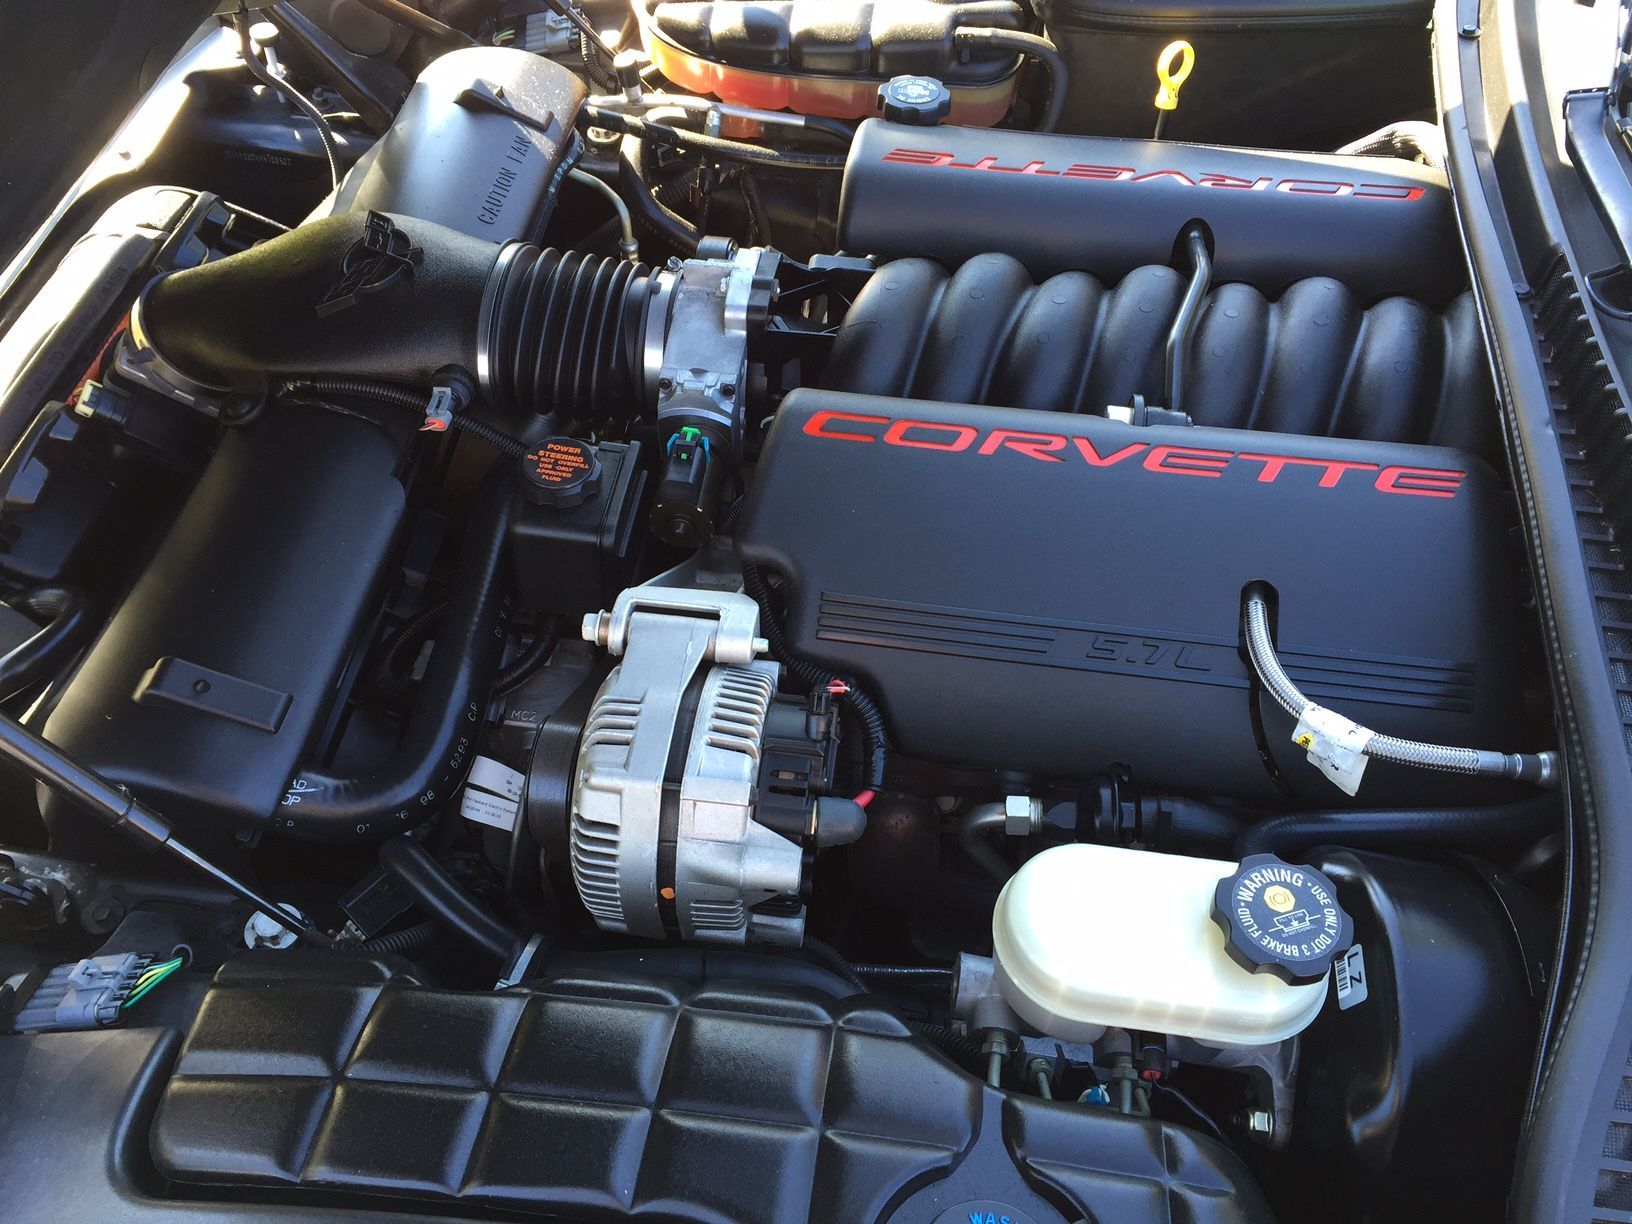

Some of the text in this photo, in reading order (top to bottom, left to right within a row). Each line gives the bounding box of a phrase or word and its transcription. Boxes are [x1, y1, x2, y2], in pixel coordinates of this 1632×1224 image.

[478, 135, 532, 225] CAUTION FAN
[881, 148, 1425, 200] CORVETTE
[538, 450, 584, 463] STEERING
[547, 443, 581, 454] POWER
[558, 460, 590, 469] OVERFILL
[803, 410, 1467, 498] CORVETTE
[536, 468, 572, 478] APPROVED
[1086, 635, 1212, 672] 5.7L
[1236, 868, 1304, 902] WARNING
[1237, 885, 1338, 957] USE ONLY DOT 3 BRAKE FLUID
[968, 1212, 1019, 1224] WAS
